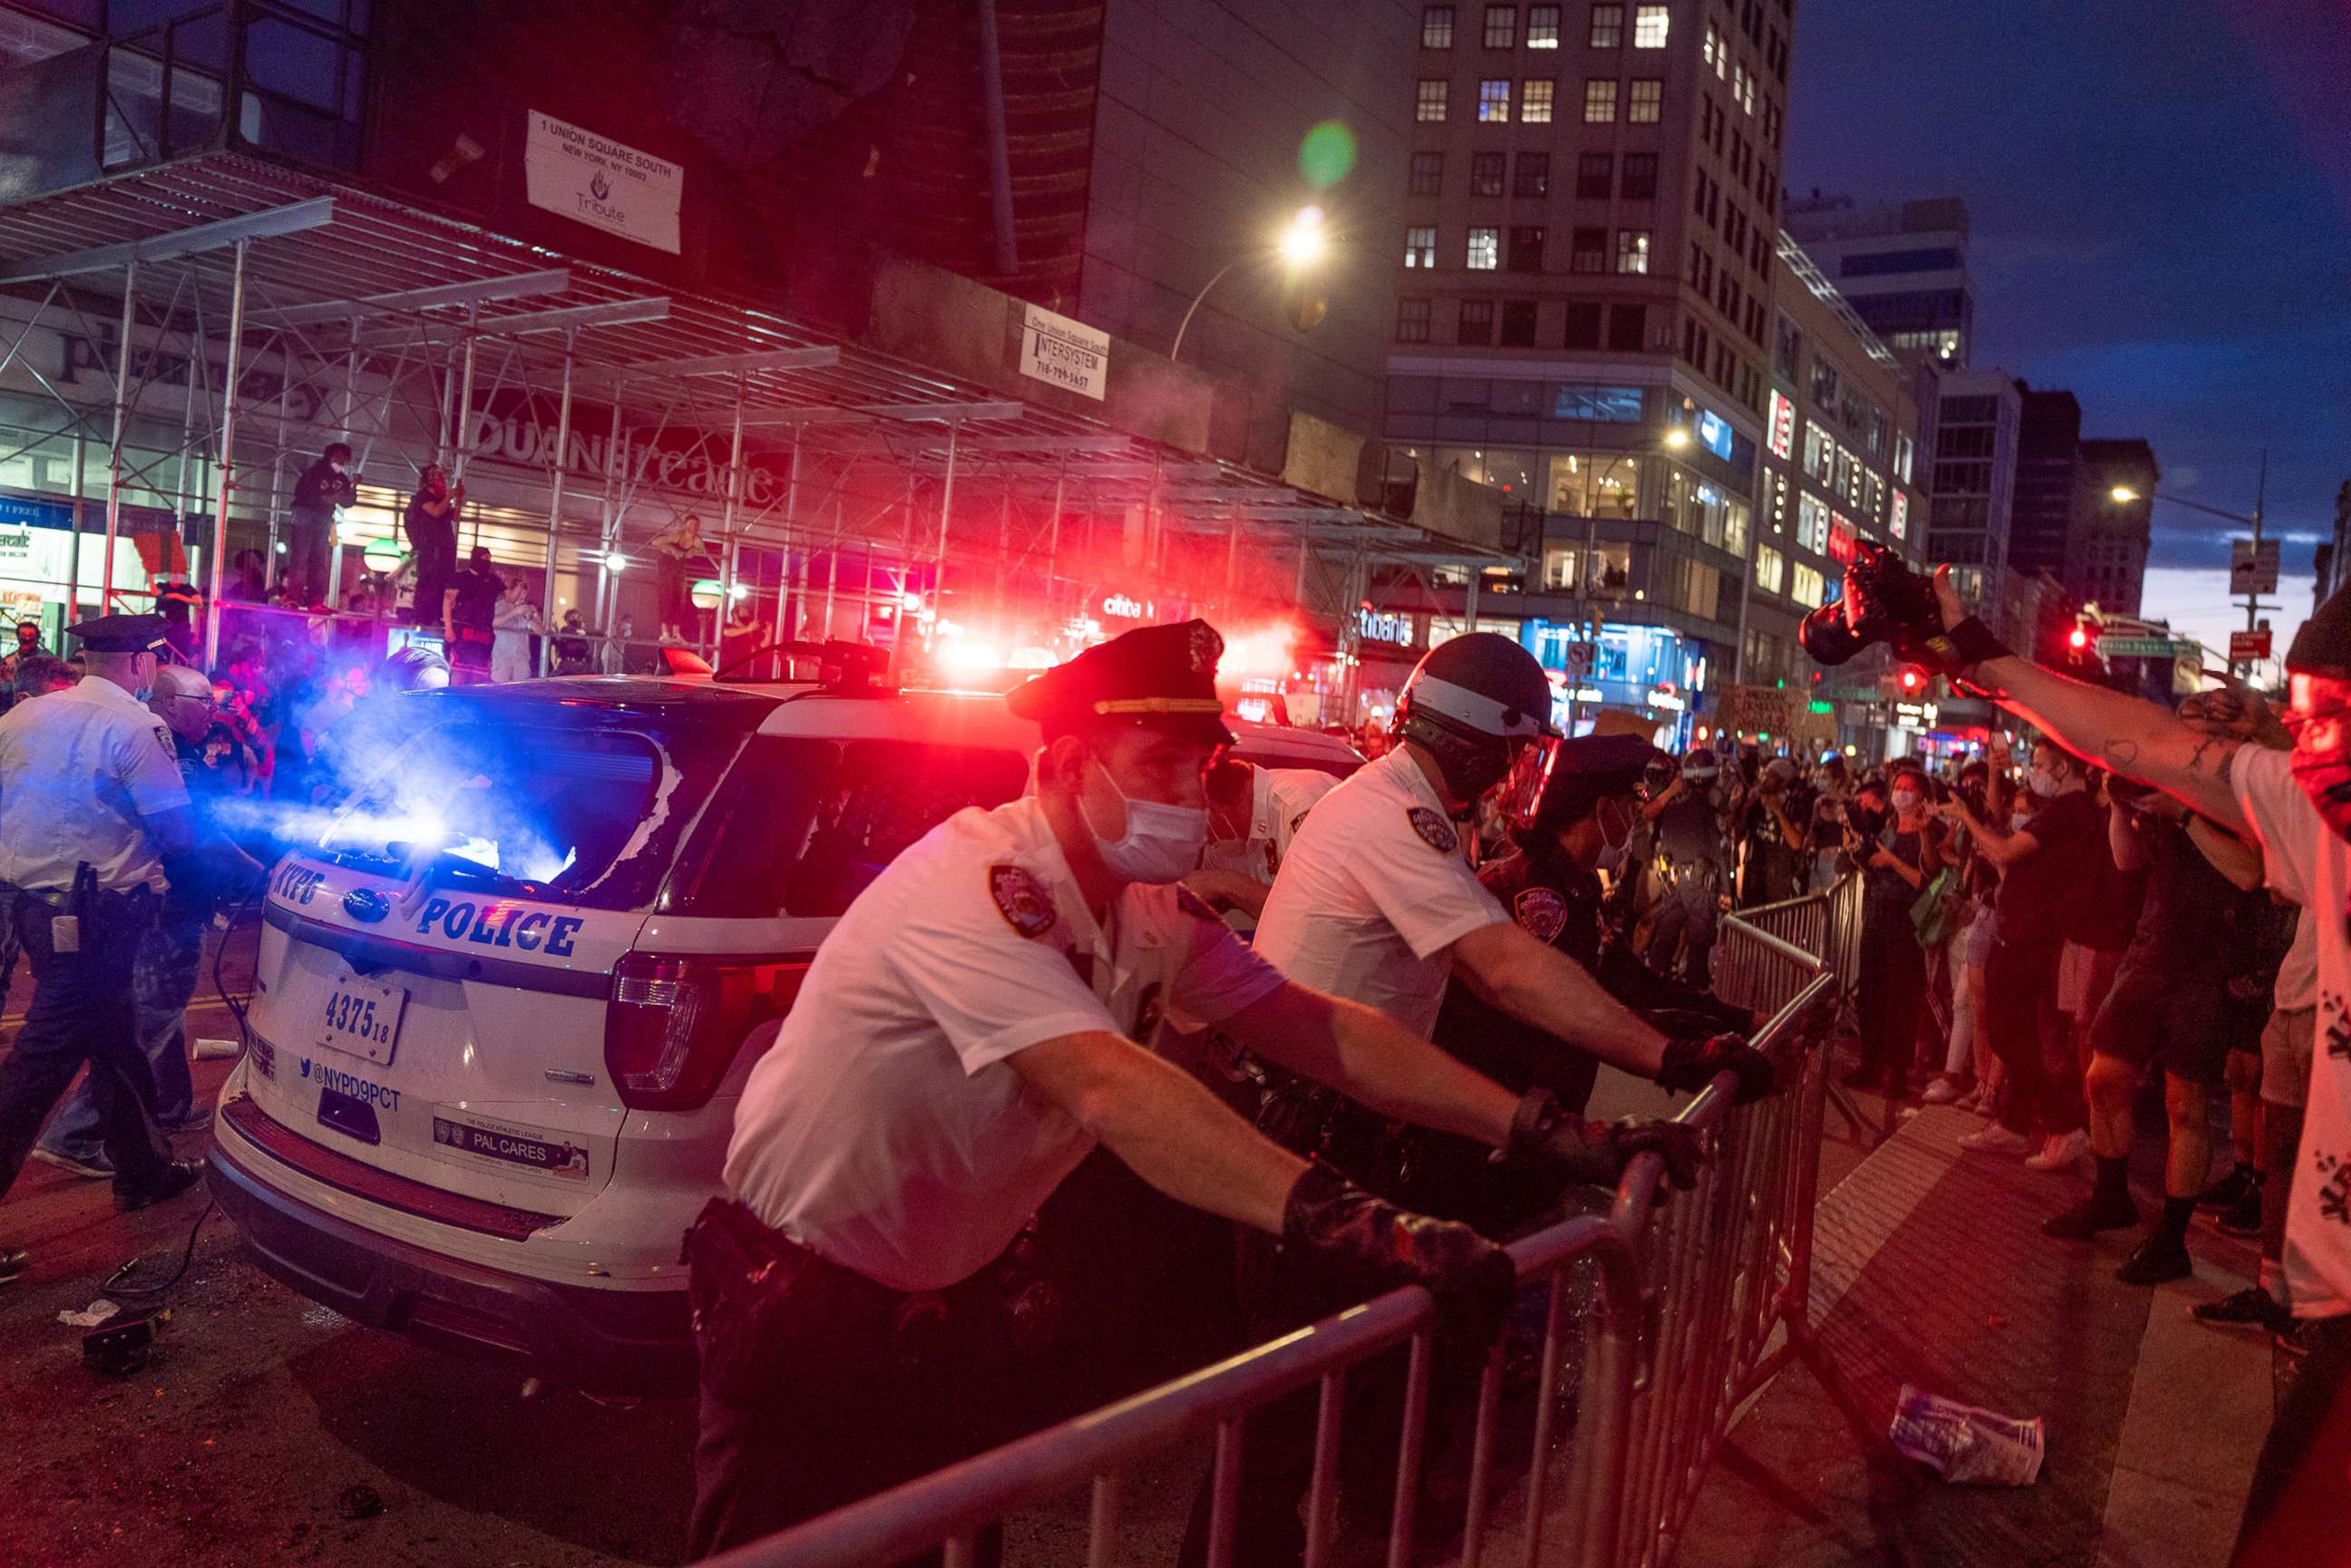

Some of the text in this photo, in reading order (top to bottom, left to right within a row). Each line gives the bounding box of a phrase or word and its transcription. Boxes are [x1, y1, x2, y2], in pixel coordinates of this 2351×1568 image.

[541, 120, 672, 179] 1 UNION SQUARE SOUTH
[562, 143, 582, 161] NEW
[610, 162, 622, 173] NY
[576, 191, 625, 222] Tribute
[1032, 316, 1046, 328] One
[1047, 324, 1067, 338] Union
[1033, 332, 1098, 371] INTERSYSTEM
[274, 862, 327, 906] NYPD
[416, 897, 585, 958] POLICE
[326, 991, 390, 1044] 4375 18
[313, 1063, 401, 1112] @NYPD9PCT
[473, 1133, 547, 1161] PAL CARES
